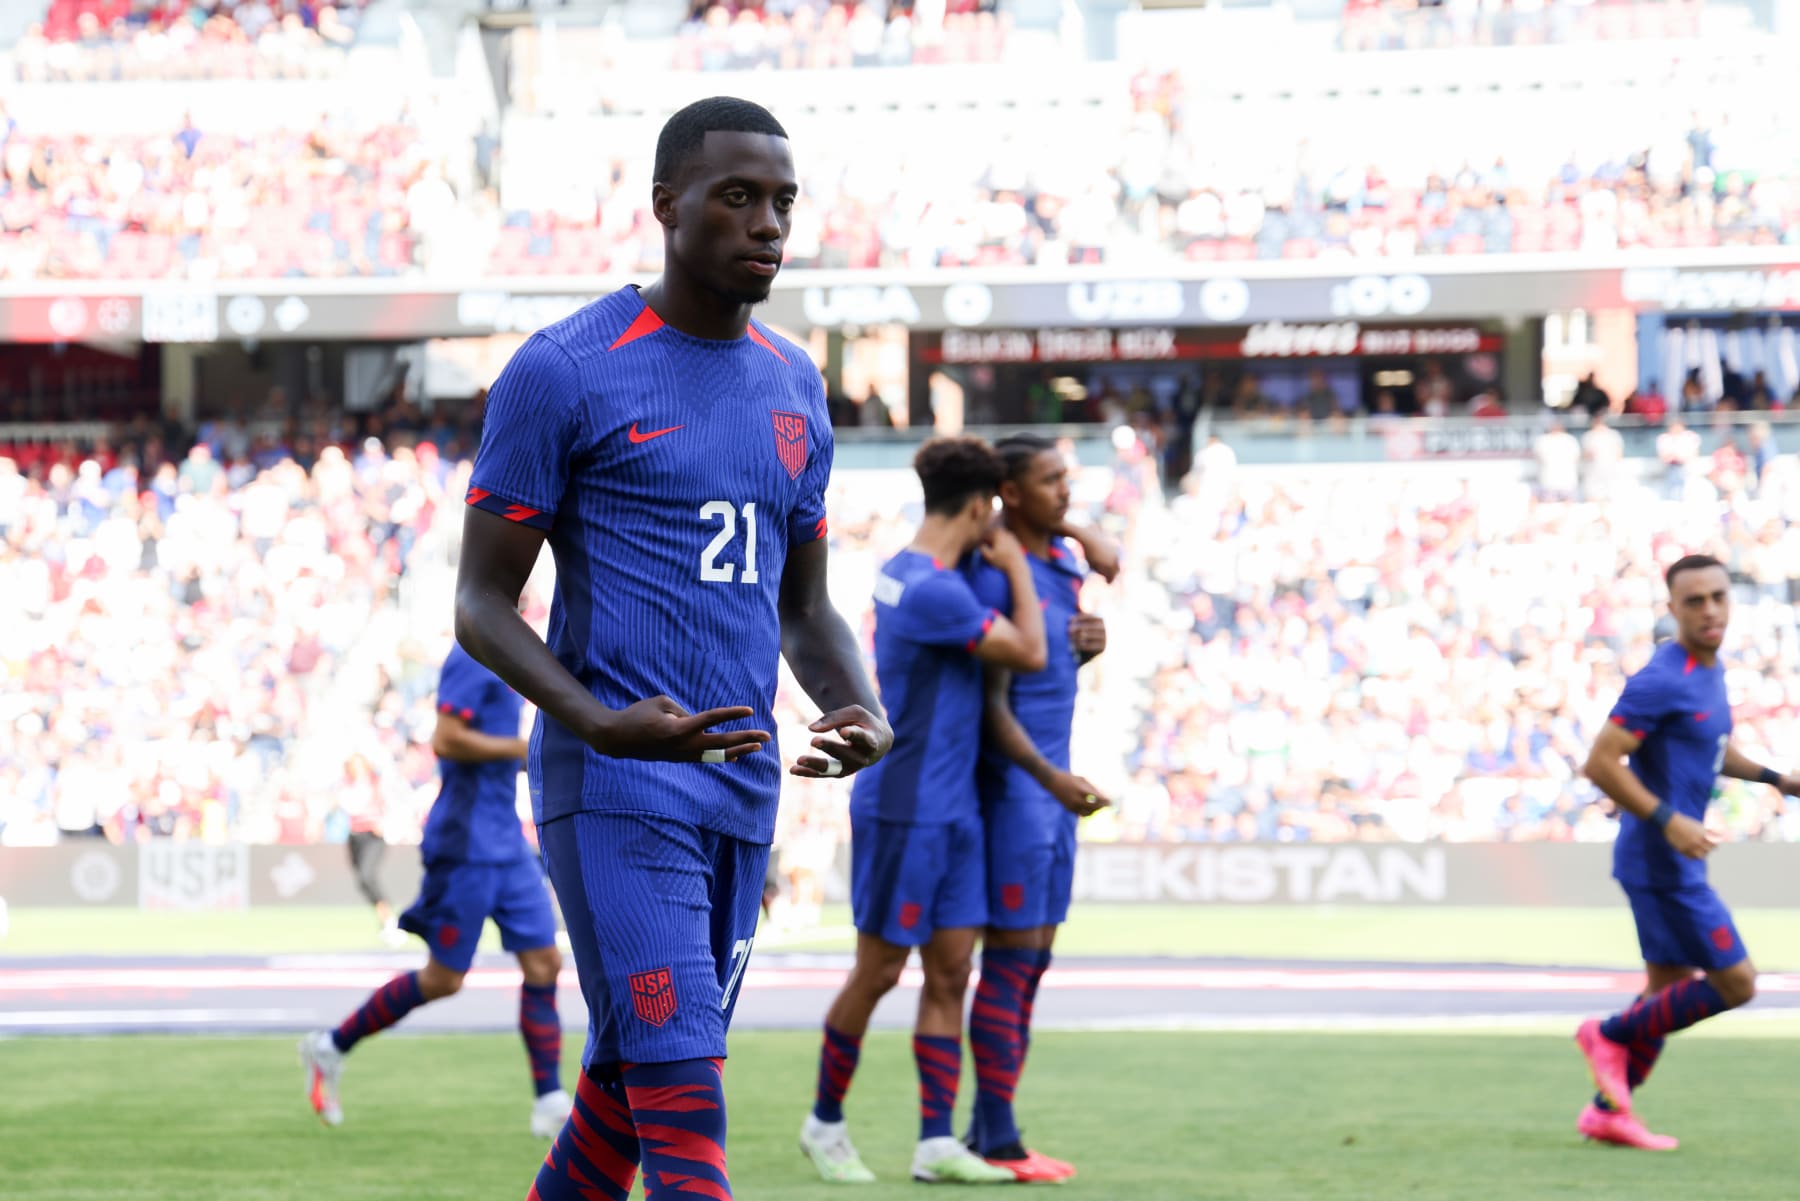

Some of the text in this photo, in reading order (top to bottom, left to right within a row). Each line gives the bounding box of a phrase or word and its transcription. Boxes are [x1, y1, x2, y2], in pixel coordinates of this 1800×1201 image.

[804, 285, 920, 323] USA
[774, 415, 802, 440] USA
[700, 500, 758, 584] 21
[148, 848, 237, 888] USA
[632, 971, 670, 995] USA
